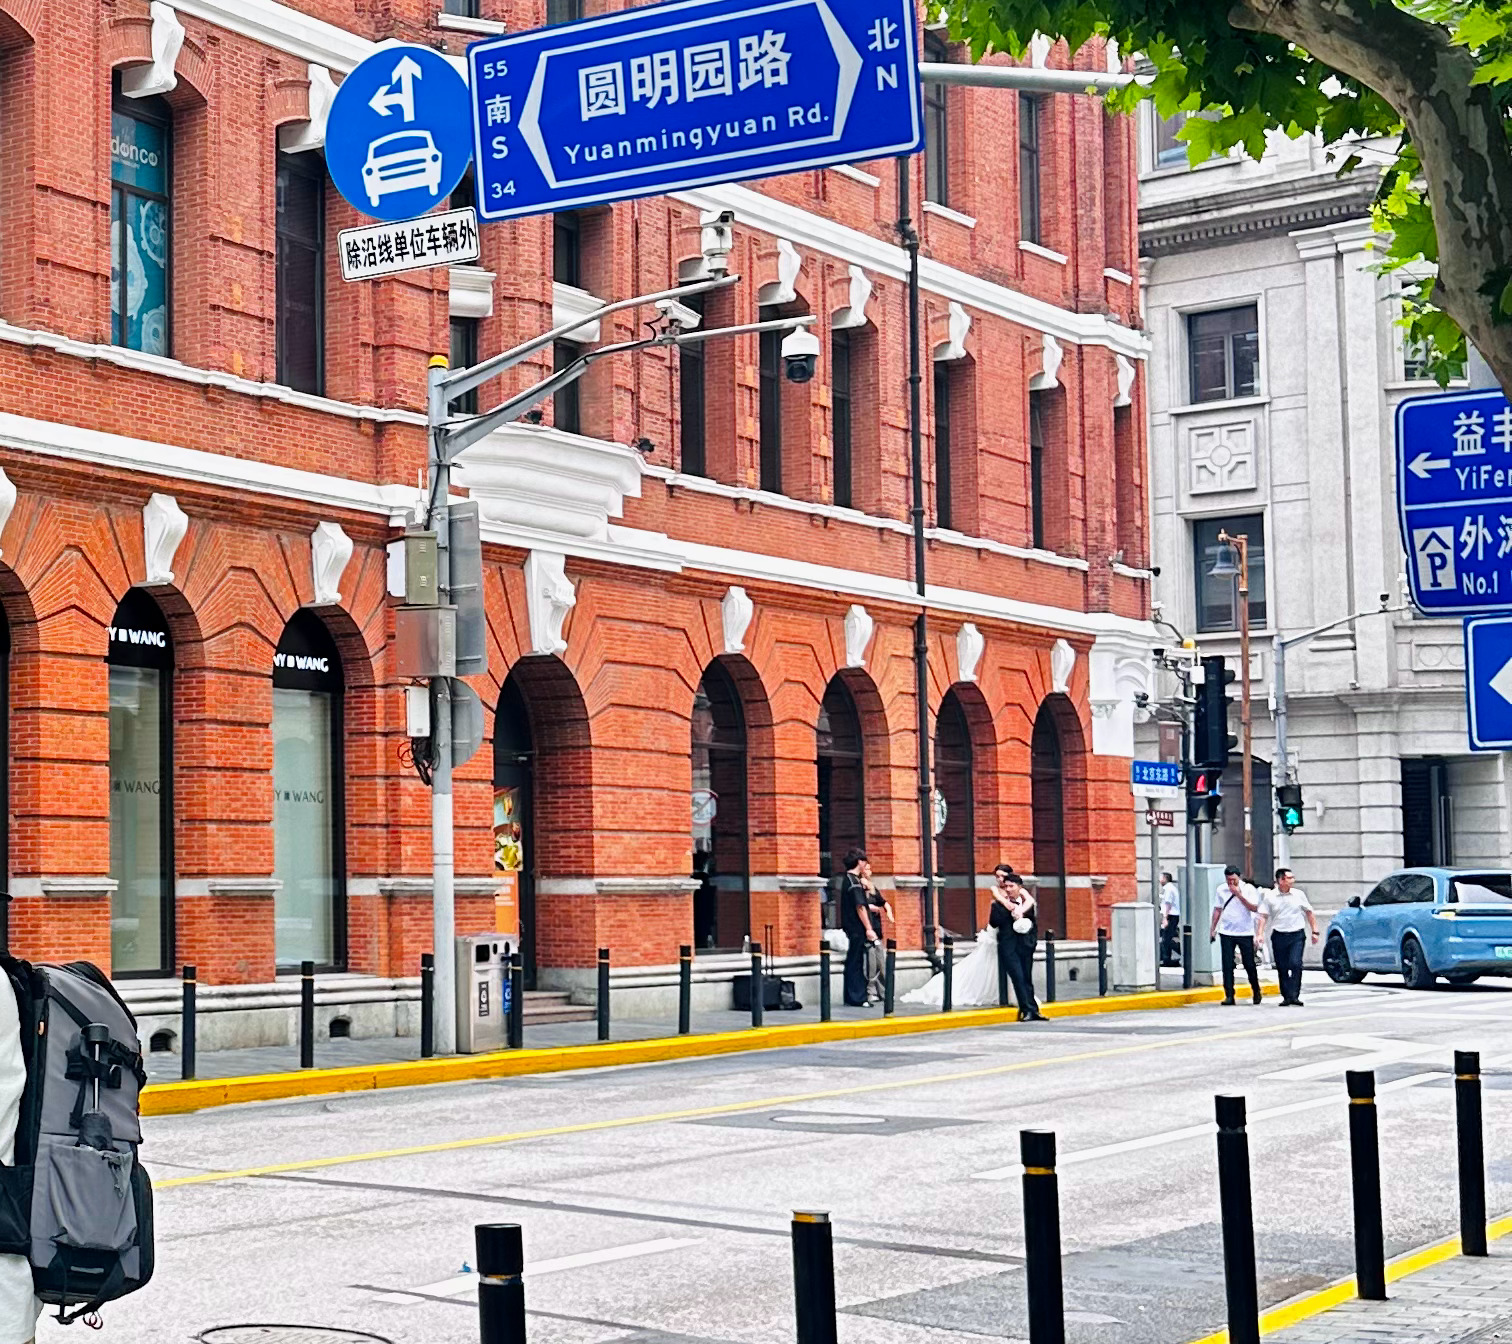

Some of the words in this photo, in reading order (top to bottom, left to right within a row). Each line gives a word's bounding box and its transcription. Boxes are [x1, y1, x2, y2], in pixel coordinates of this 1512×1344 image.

[866, 17, 900, 53] 北
[483, 60, 509, 80] 55
[578, 28, 793, 123] 圆明园路
[875, 64, 900, 93] N
[485, 94, 513, 128] 南
[564, 113, 777, 166] Yuanmingyuan
[788, 102, 830, 128] Rd.
[491, 136, 510, 160] S
[491, 180, 517, 200] 34
[345, 218, 477, 271] 除沿线单位车辆外
[1426, 552, 1448, 588] P
[1462, 570, 1498, 596] No.1
[128, 629, 166, 648] WANG
[295, 655, 330, 673] WANG
[124, 780, 160, 795] WANG
[292, 790, 325, 804] WANG
